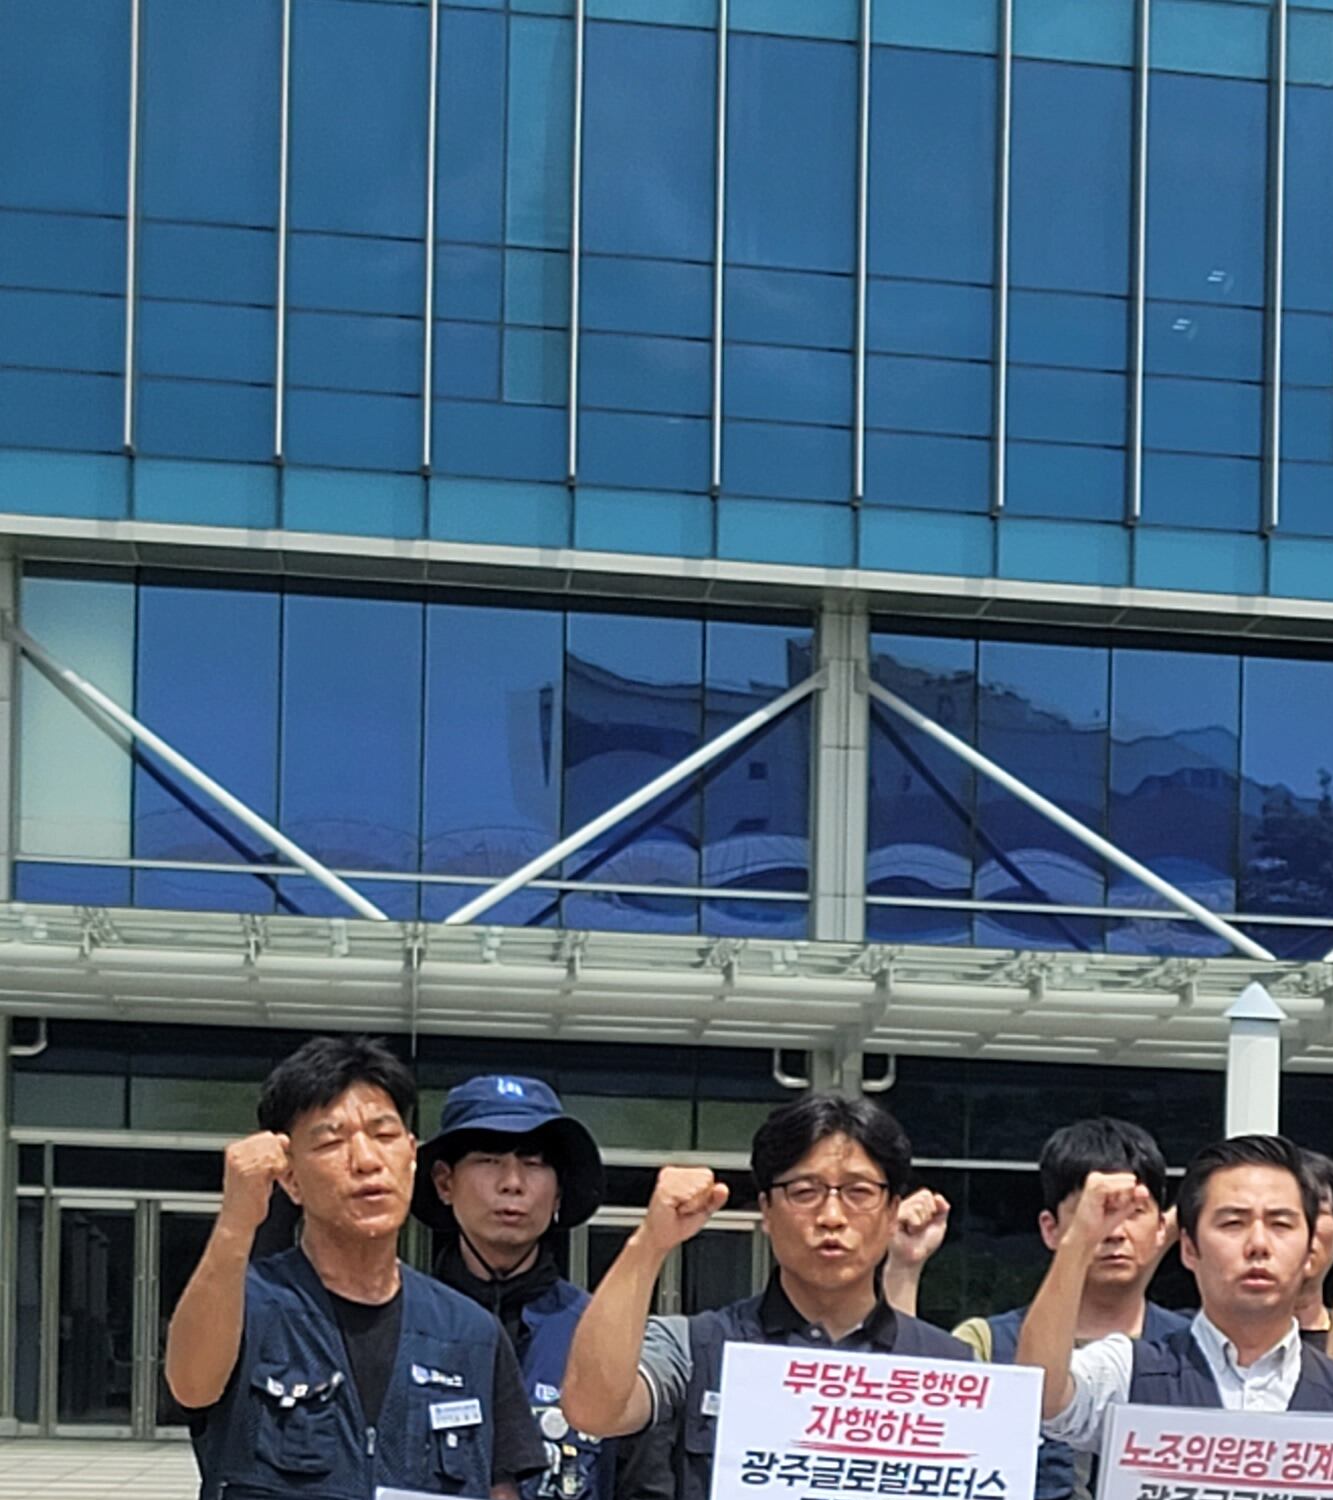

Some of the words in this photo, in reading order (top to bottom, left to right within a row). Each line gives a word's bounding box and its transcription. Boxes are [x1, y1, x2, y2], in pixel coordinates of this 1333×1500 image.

[783, 1361, 990, 1408] 부당노동행위
[805, 1406, 945, 1446] 자행하는
[1120, 1431, 1277, 1479] 노조위원장
